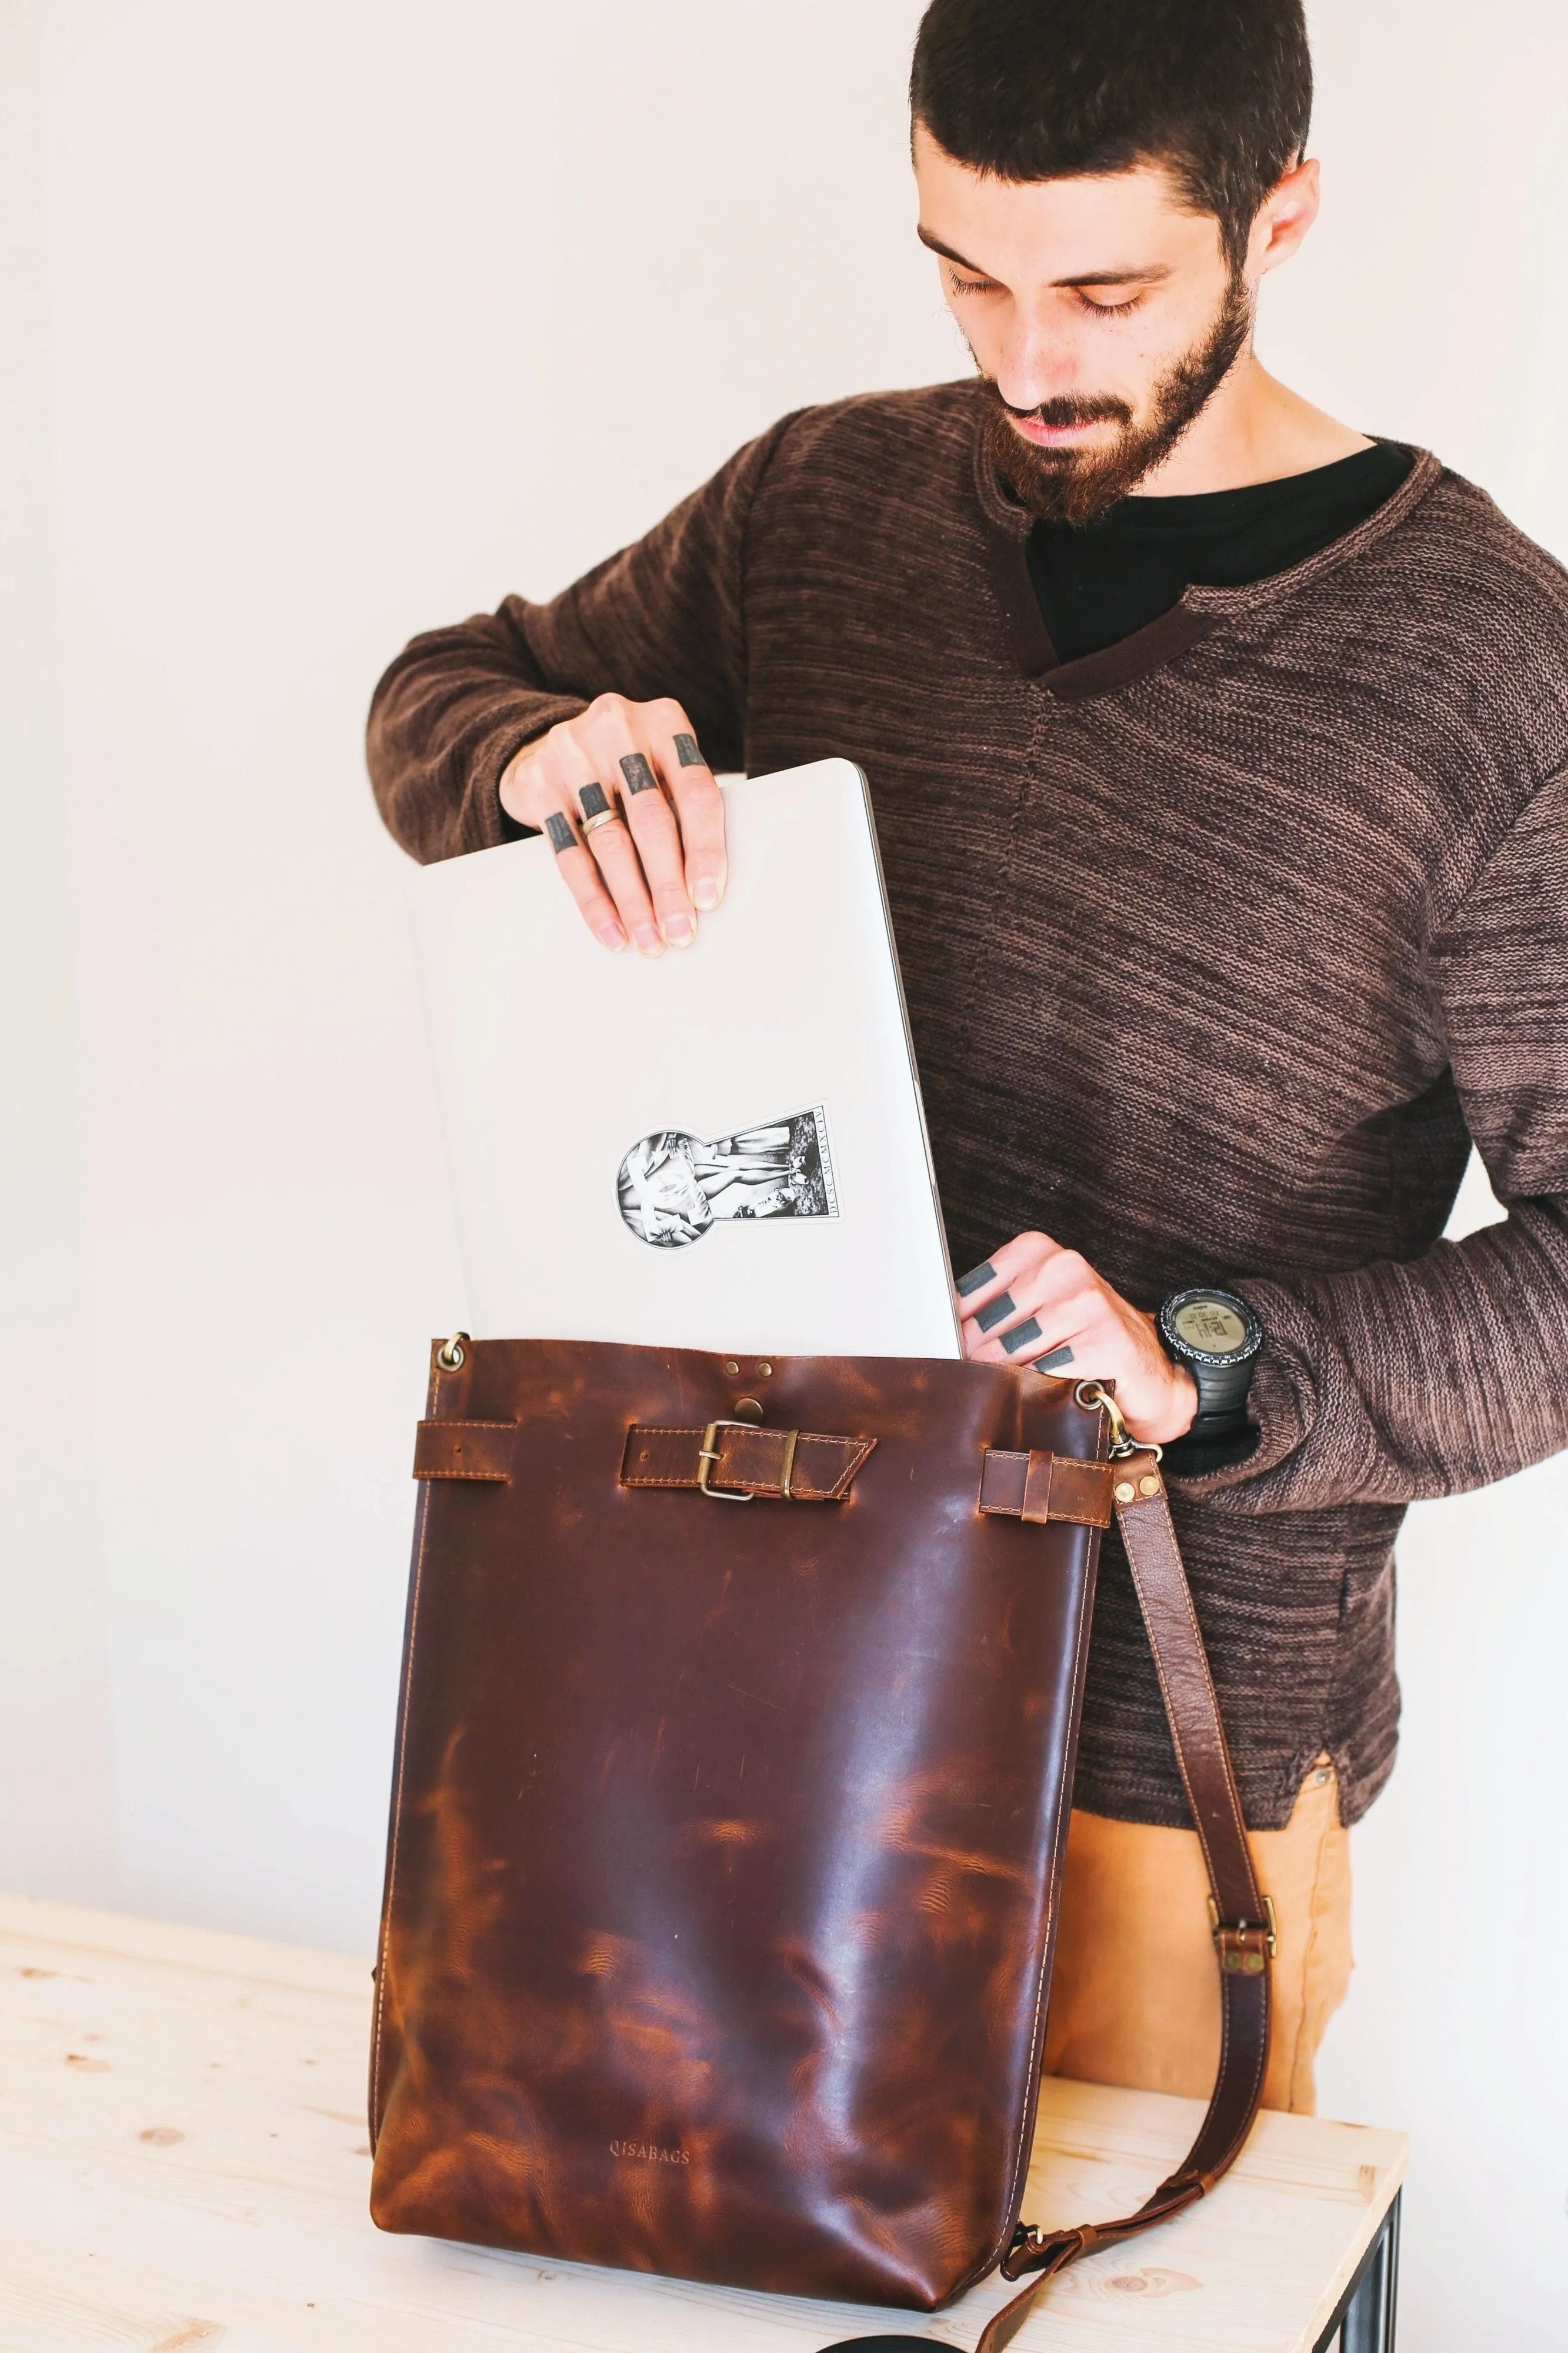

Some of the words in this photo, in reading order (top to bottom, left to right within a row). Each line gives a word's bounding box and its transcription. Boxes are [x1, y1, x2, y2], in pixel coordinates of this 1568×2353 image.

[815, 1110, 832, 1175] MCMXCIV
[825, 1179, 837, 1214] DCSC
[610, 2139, 690, 2165] QISABAGS
